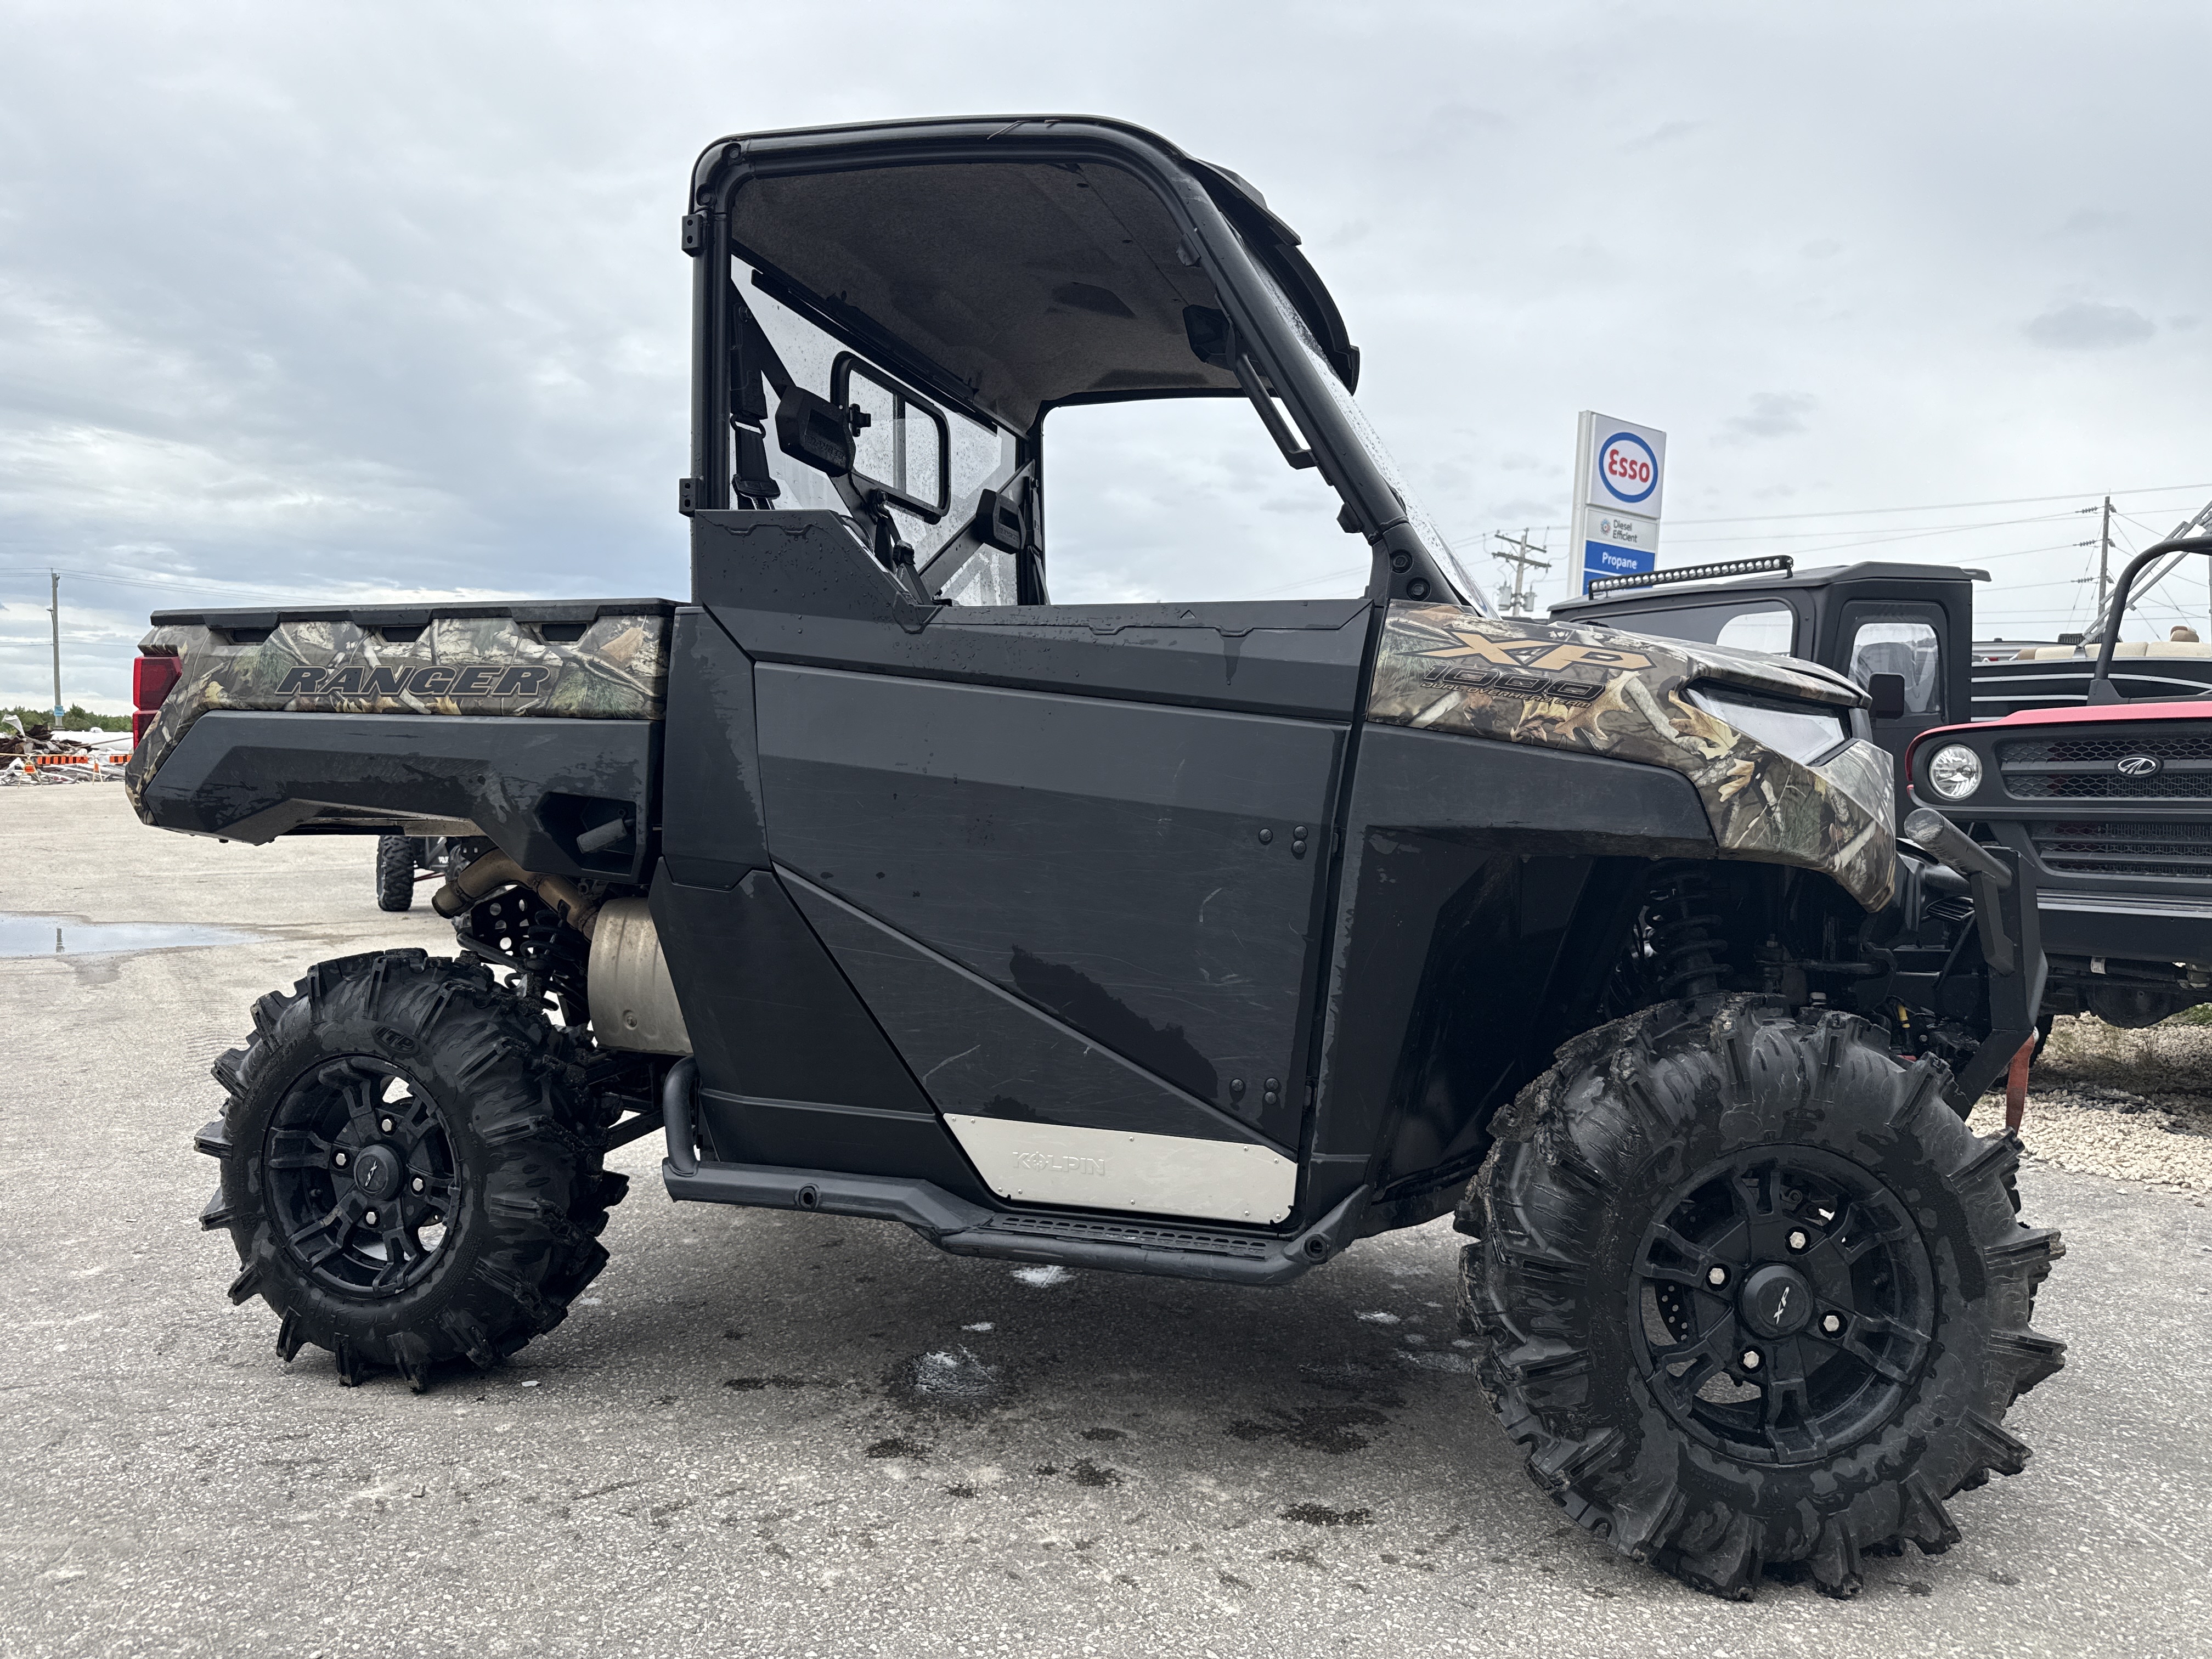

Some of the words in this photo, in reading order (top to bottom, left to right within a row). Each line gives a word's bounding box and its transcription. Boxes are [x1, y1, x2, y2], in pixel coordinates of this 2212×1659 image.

[1612, 529, 1638, 543] Efficient
[1613, 519, 1632, 531] Diesel
[1602, 551, 1638, 570] Propane
[1396, 627, 1657, 673] XP
[275, 664, 551, 697] RANGER
[1421, 663, 1606, 701] 1000
[1421, 682, 1464, 692] DUAL
[1466, 687, 1553, 703] OVERHEAD
[1554, 698, 1592, 709] CAM
[375, 1026, 415, 1048] ITP
[1012, 1151, 1105, 1176] KOLPIN
